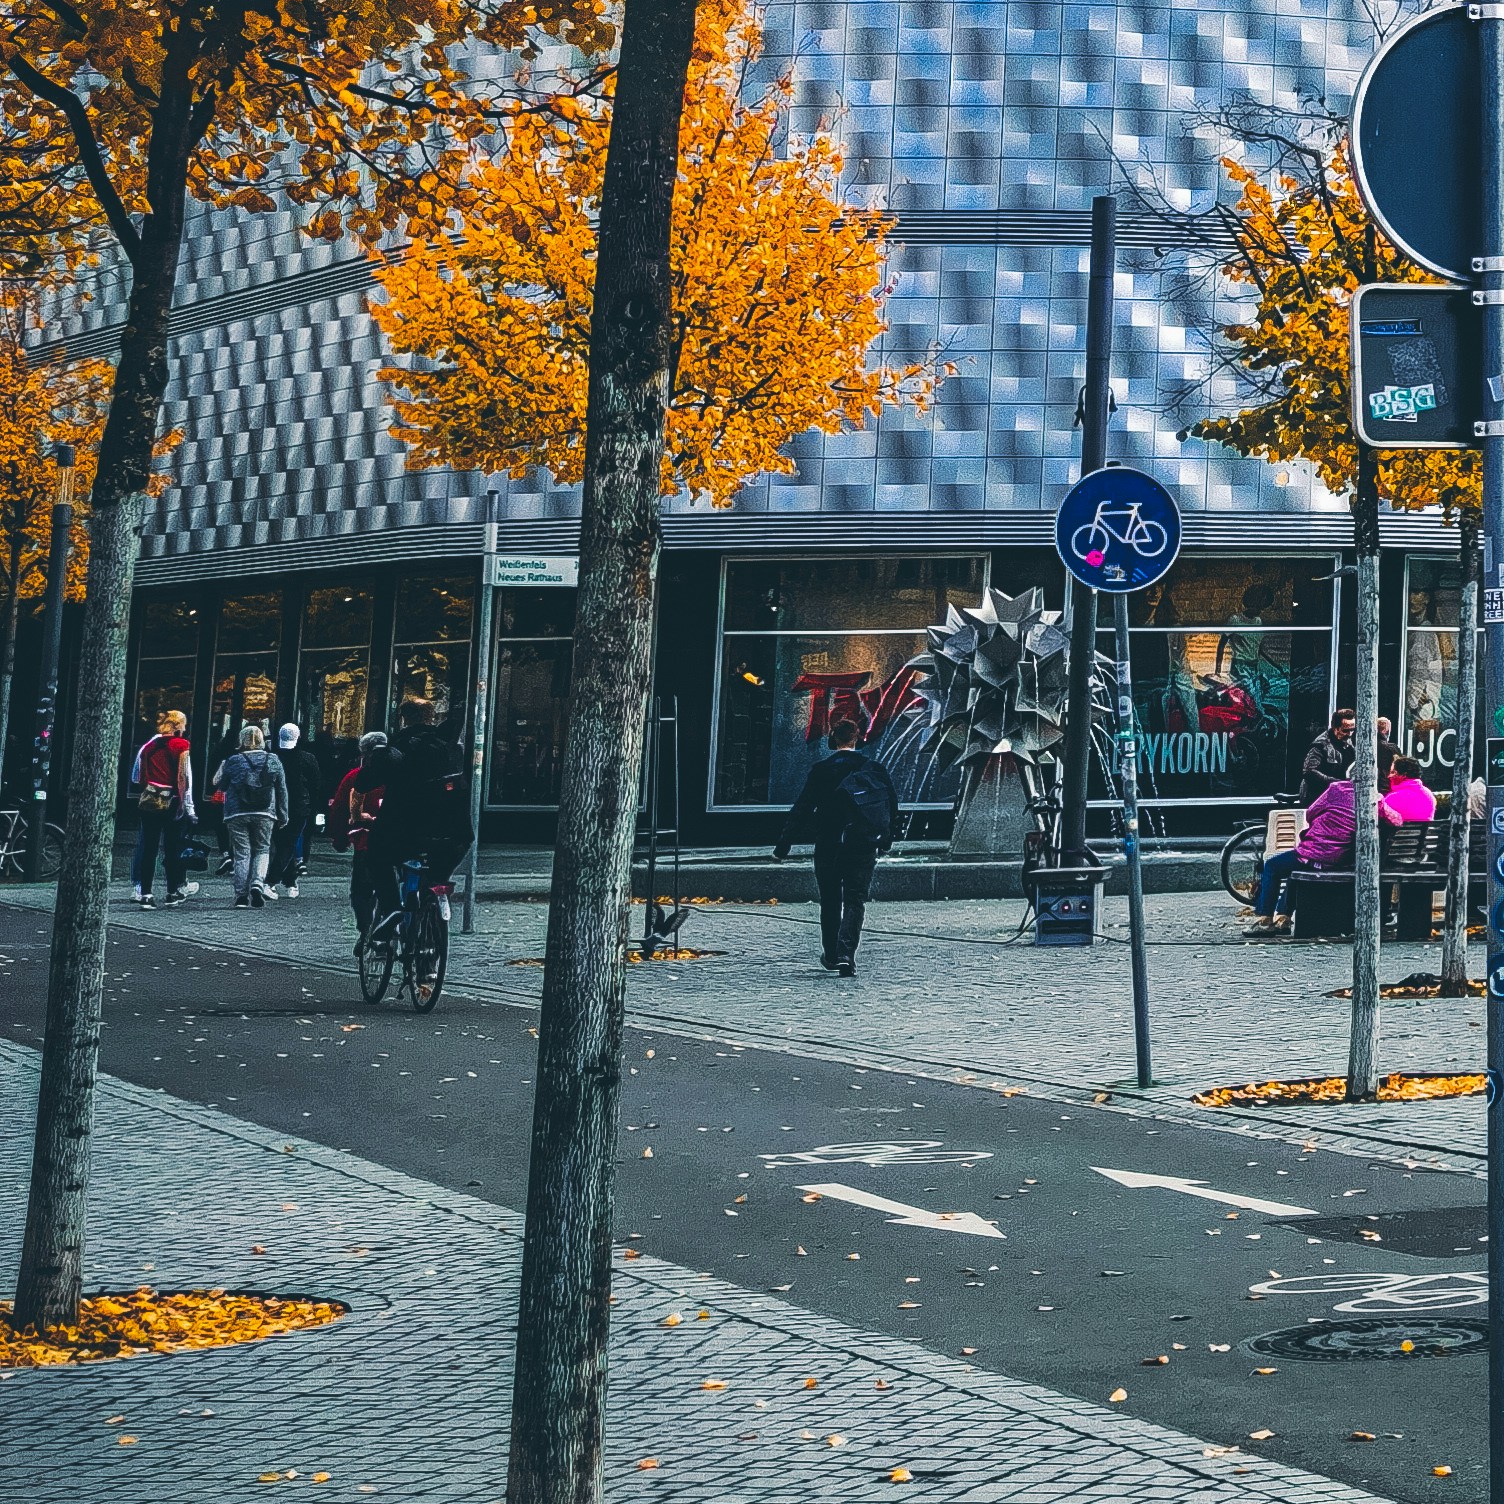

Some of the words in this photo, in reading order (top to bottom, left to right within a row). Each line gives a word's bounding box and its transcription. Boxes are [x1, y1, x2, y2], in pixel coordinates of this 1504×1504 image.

[1372, 388, 1433, 416] BSG
[498, 572, 526, 582] Neues
[528, 572, 563, 582] Rathaus
